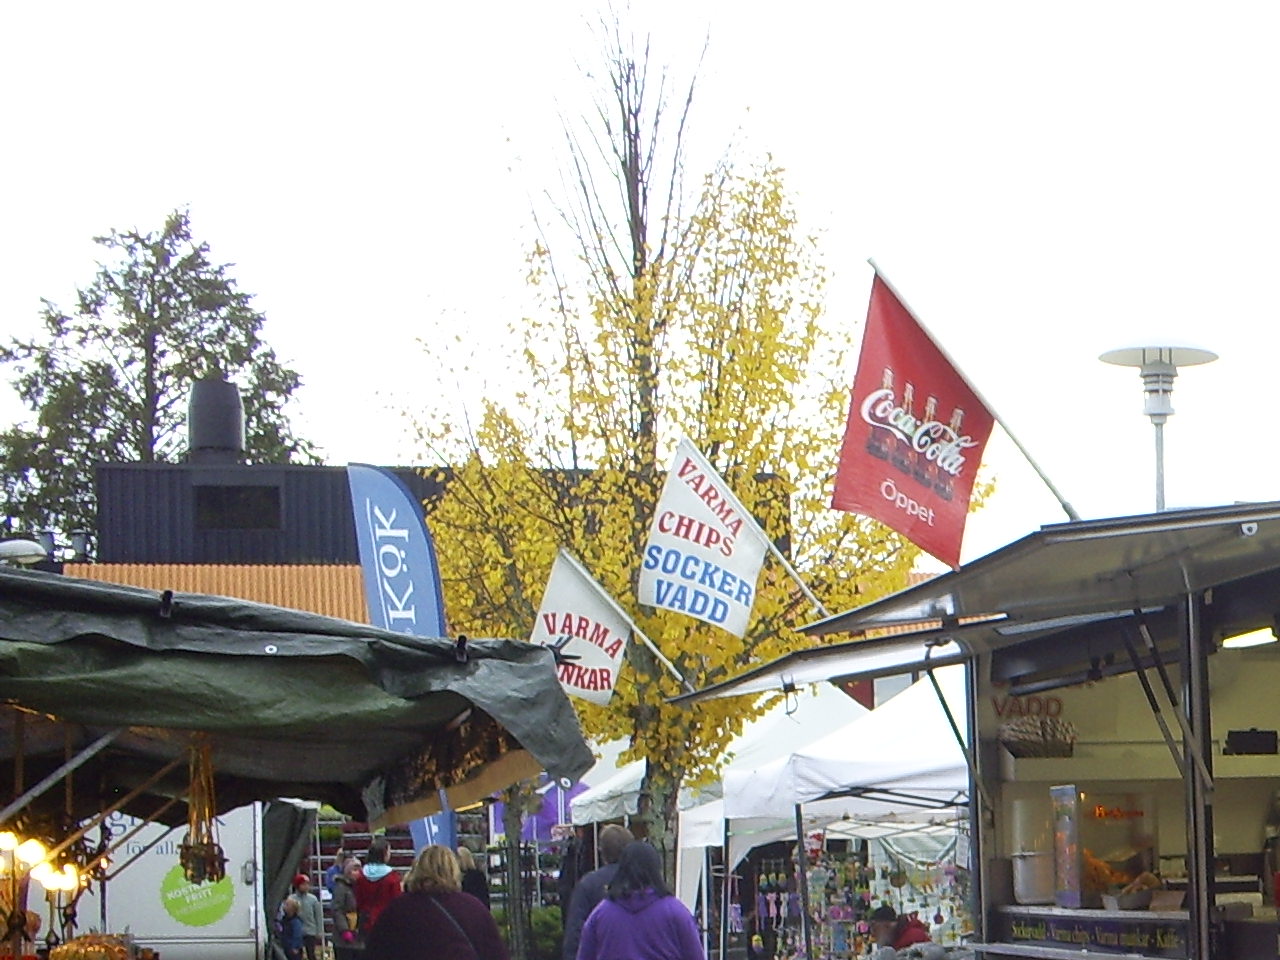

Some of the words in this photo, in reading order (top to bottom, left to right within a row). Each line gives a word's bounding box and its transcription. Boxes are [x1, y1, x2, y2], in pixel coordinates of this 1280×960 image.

[677, 457, 743, 539] VARMA
[880, 478, 935, 527] Öppet
[658, 511, 734, 557] CHIPS
[644, 545, 752, 607] SOCKER
[656, 579, 729, 623] VADD
[543, 612, 623, 659] VARMA
[992, 695, 1063, 718] VADD
